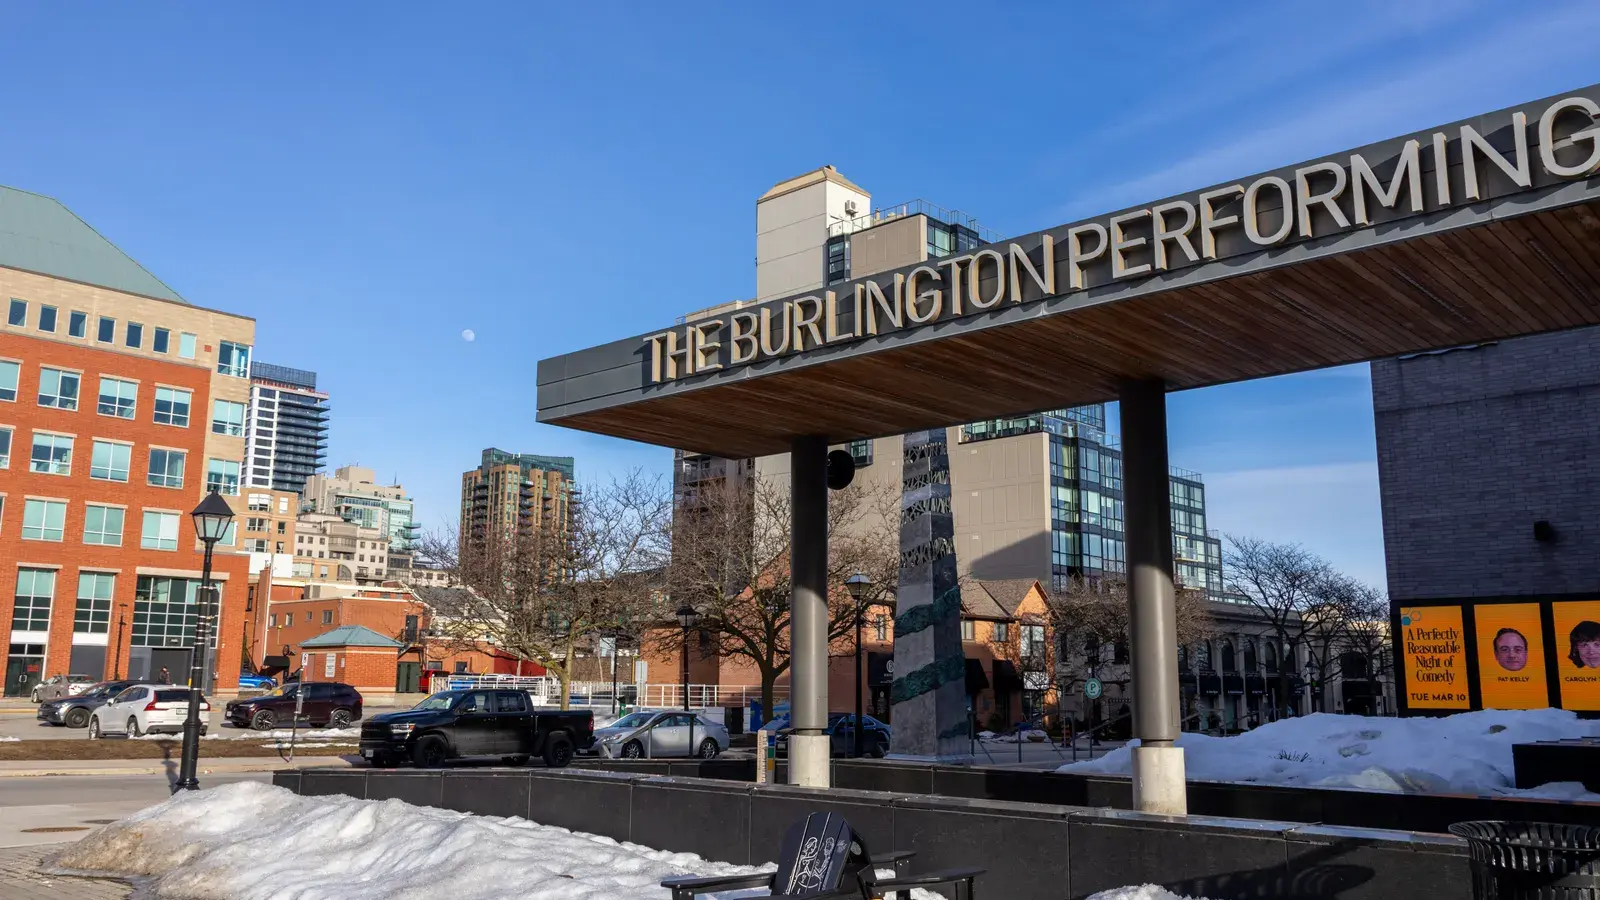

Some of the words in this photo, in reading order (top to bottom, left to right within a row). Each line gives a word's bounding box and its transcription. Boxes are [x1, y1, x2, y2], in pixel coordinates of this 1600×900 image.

[643, 319, 724, 383] THE
[730, 234, 1055, 365] BURLINGTON
[1068, 96, 1600, 290] PERFORMING
[1407, 628, 1414, 640] A
[1416, 627, 1459, 641] Perfectly
[1407, 641, 1460, 654] Reasonable
[1416, 656, 1441, 670] Night
[1444, 655, 1455, 667] of
[1416, 670, 1455, 685] Comedy
[1432, 693, 1453, 701] MAR
